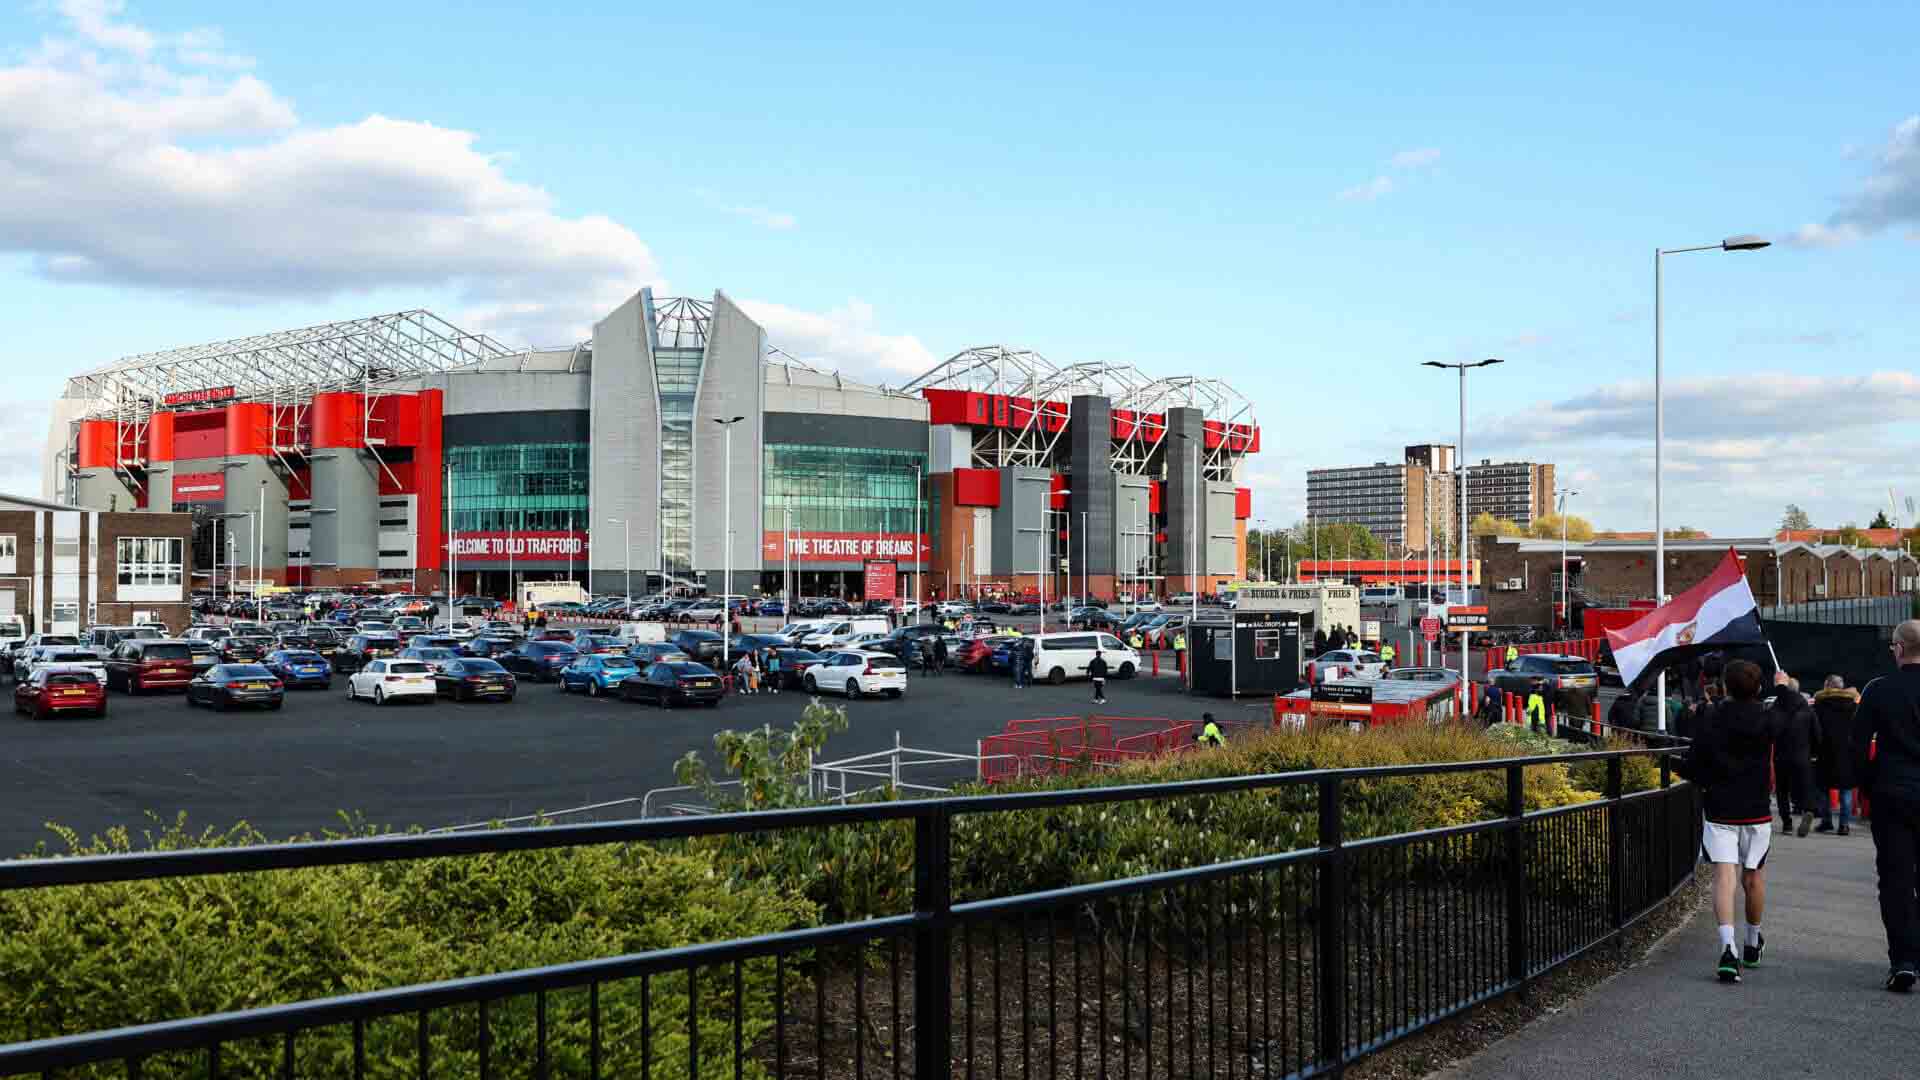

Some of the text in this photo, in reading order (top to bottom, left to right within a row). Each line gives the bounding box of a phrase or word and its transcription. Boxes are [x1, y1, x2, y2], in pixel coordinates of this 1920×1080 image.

[450, 538, 581, 554] WELCOME TO OLD TRAFFORD
[788, 539, 913, 555] THE THEATRE OF DREAMS
[1251, 589, 1311, 599] BURGER & FRIES
[1328, 589, 1351, 598] FRIES
